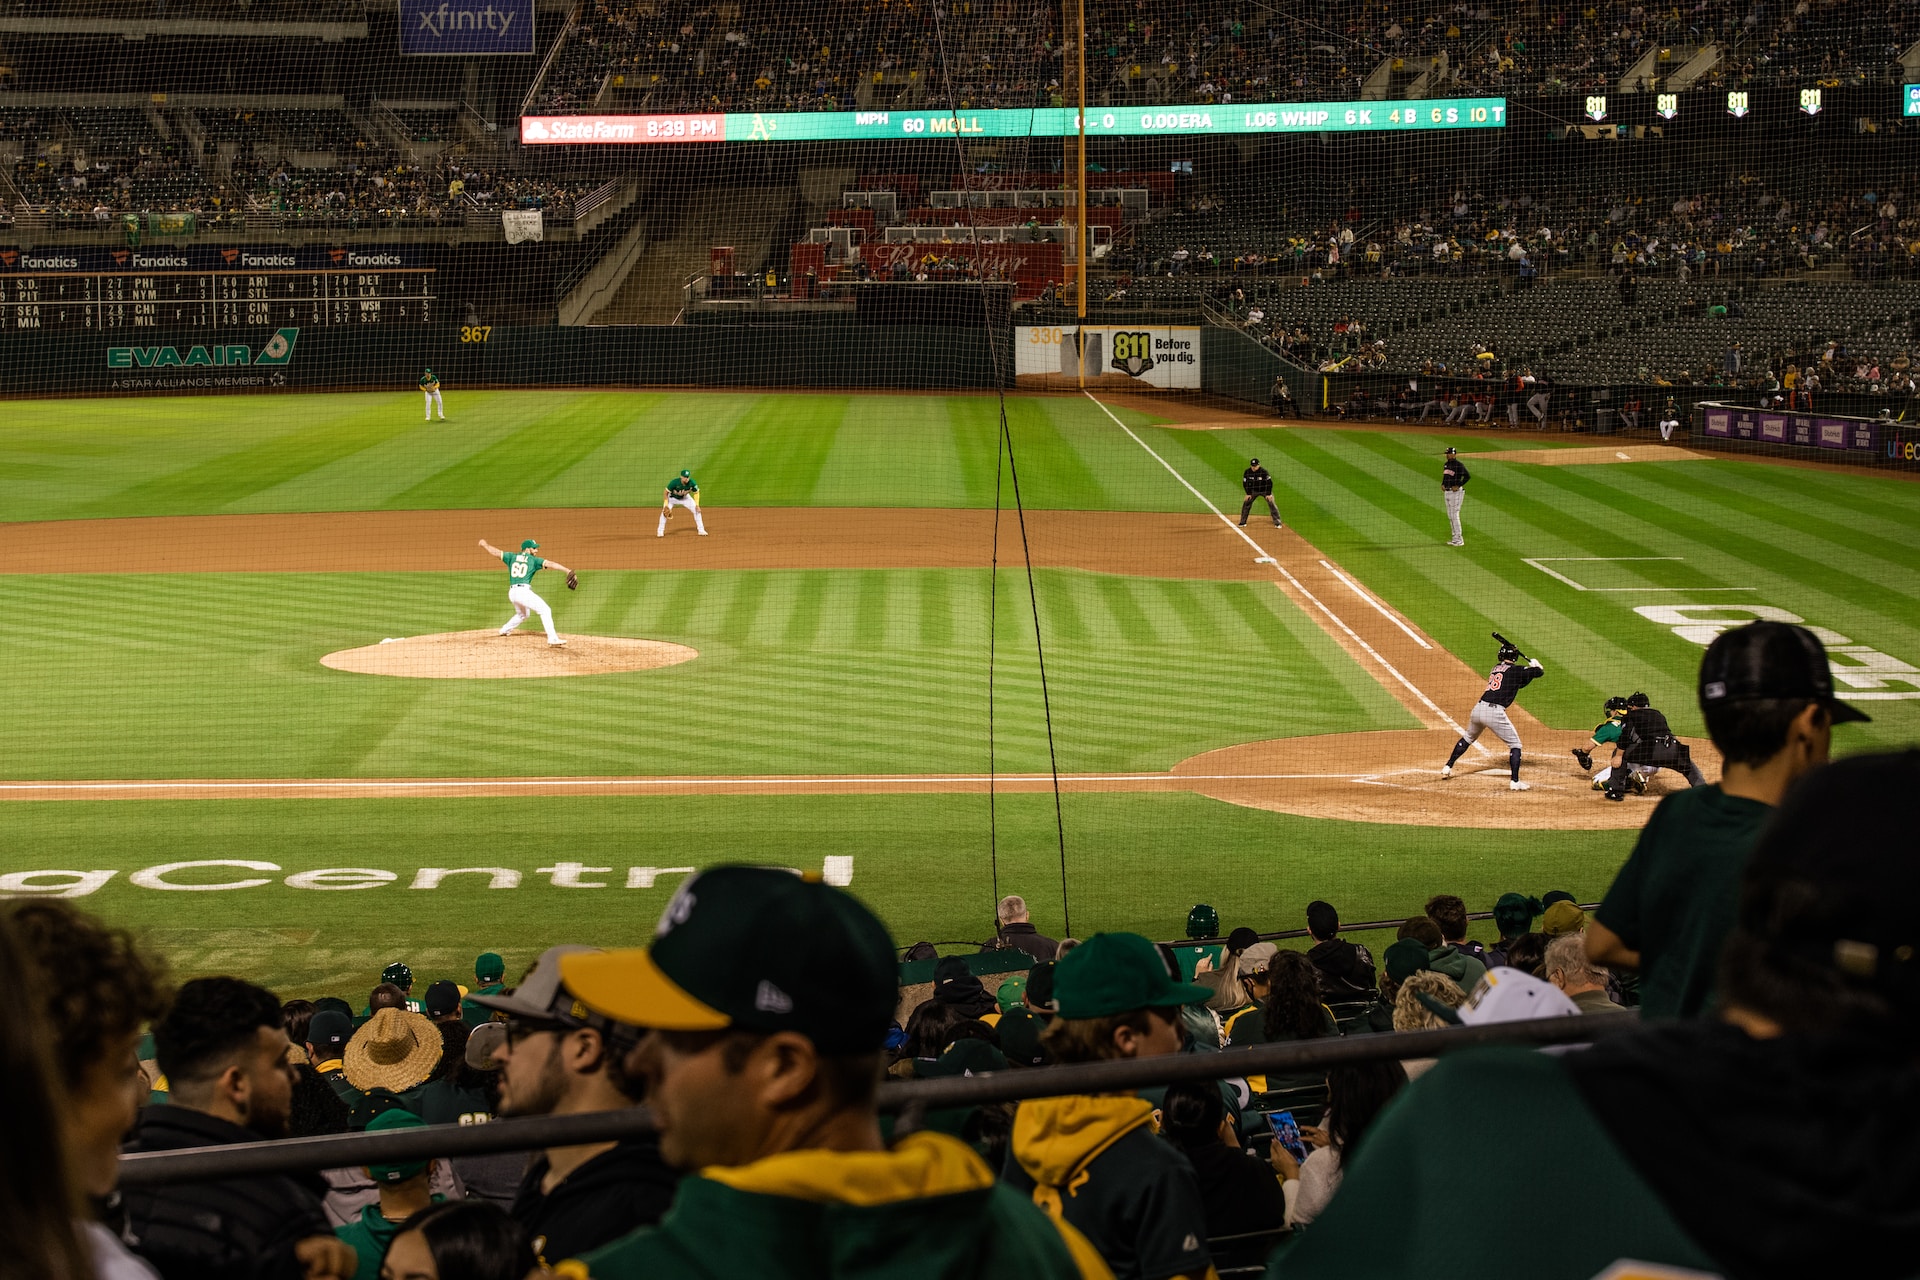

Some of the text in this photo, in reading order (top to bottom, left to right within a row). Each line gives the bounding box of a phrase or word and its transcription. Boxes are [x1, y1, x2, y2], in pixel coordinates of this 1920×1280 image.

[419, 2, 515, 37] xfinity
[1657, 94, 1676, 110] 811
[1728, 92, 1748, 108] 811
[1801, 89, 1820, 106] 811
[1586, 96, 1606, 112] 811
[856, 112, 889, 125] MPH
[1280, 111, 1329, 126] WHIP
[1344, 110, 1372, 124] 6 K
[1389, 108, 1416, 124] 4 B
[1431, 108, 1458, 122] 6 S
[1470, 106, 1504, 122] 10 T
[903, 117, 984, 133] 60 MOLL
[1103, 114, 1114, 128] 0
[647, 120, 717, 137] 8:39 PM
[21, 255, 78, 268] Fanatics
[132, 254, 188, 268] Fanatics
[242, 253, 296, 266] Fanatics
[348, 252, 401, 265] Fanatics
[85, 278, 90, 288] 7
[134, 278, 154, 288] PHI
[200, 277, 206, 287] 0
[249, 276, 269, 286] ARI
[312, 276, 318, 286] 6
[358, 275, 380, 285] DET
[399, 281, 405, 291] 4
[60, 285, 65, 295] F
[175, 284, 180, 294] F
[288, 282, 294, 292] 9
[359, 287, 380, 297] L.A.
[423, 286, 428, 296] 4
[20, 291, 38, 301] PIT
[85, 290, 90, 300] 3
[132, 290, 157, 300] NYM
[200, 289, 206, 299] 3
[248, 289, 269, 299] STL
[313, 288, 318, 298] 2
[18, 306, 40, 316] SEA
[85, 305, 91, 315] 6
[135, 304, 155, 314] CHI
[201, 304, 206, 314] 1
[249, 302, 269, 313] CIN
[360, 301, 381, 311] WSH
[423, 300, 429, 310] 5
[400, 306, 405, 316] 5
[60, 311, 65, 321] F
[176, 310, 181, 320] F
[248, 314, 270, 324] COL
[313, 313, 319, 323] 9
[289, 308, 295, 318] 8
[361, 312, 380, 322] S.F.
[424, 312, 429, 322] 2
[17, 318, 40, 328] MIA
[86, 317, 91, 327] 8
[135, 316, 155, 326] MIL
[461, 326, 492, 342] 367
[1030, 328, 1062, 344] 330
[1114, 332, 1150, 360] 811
[1155, 338, 1190, 350] Before
[1156, 352, 1196, 364] you dig.
[112, 376, 265, 388] A STAR ALLIANCE MEMBER
[511, 562, 528, 578] 60
[0, 855, 854, 898] gCentrl
